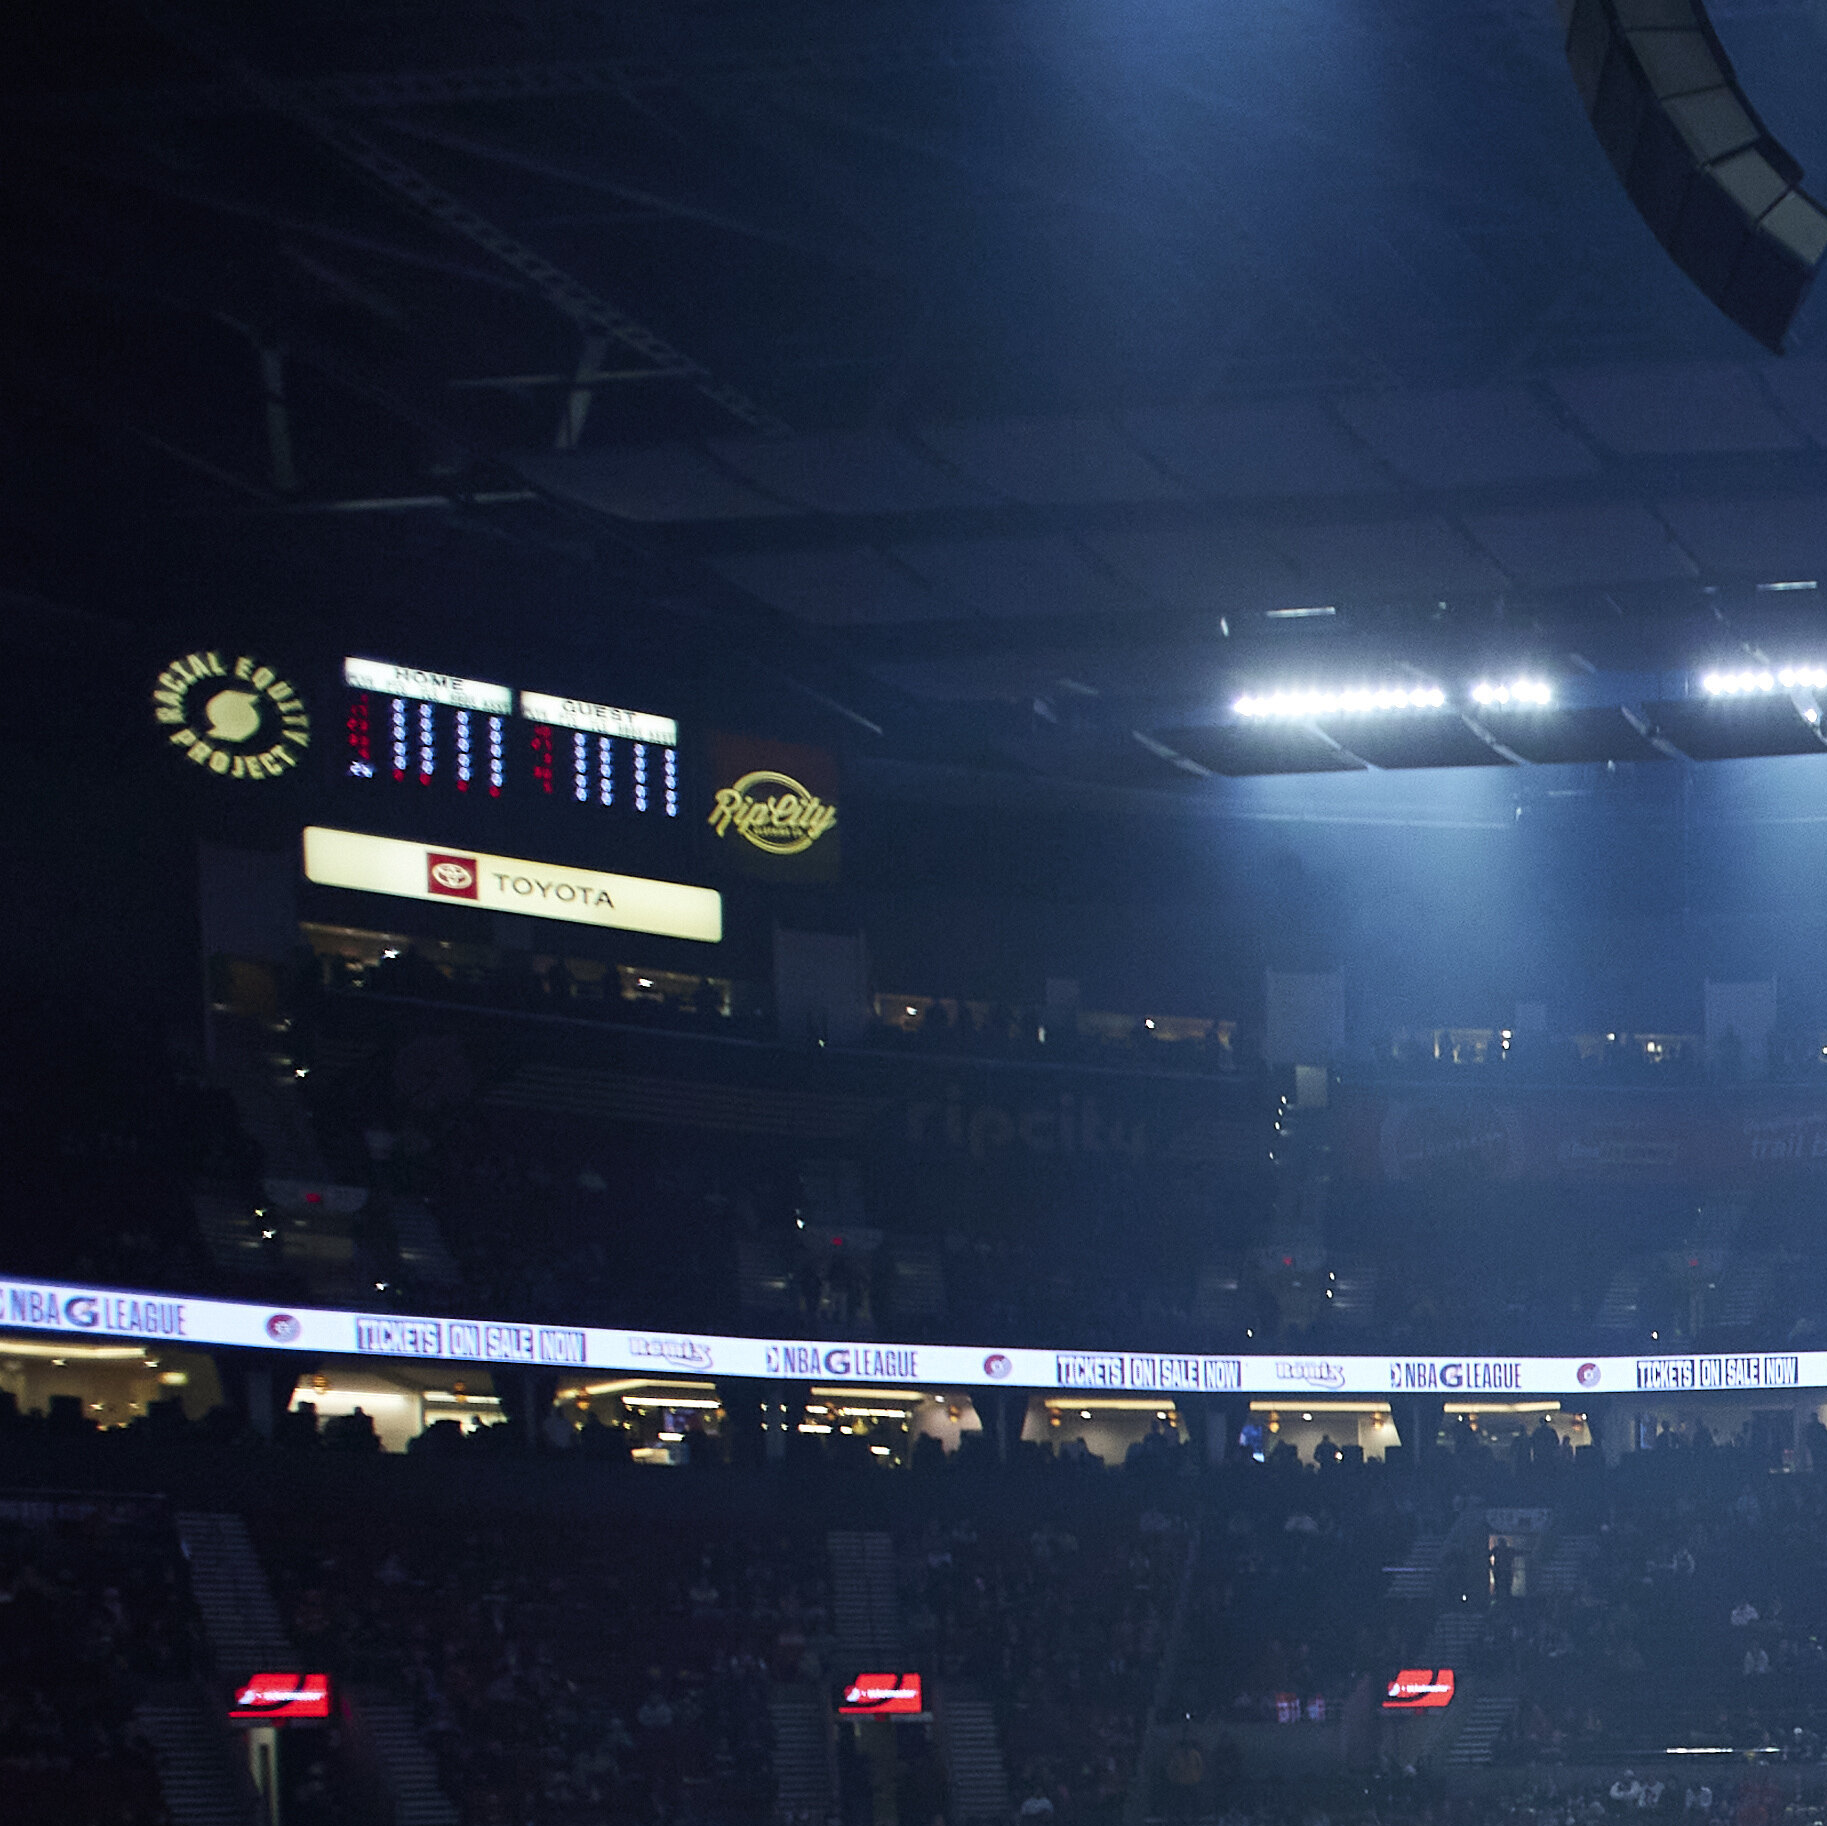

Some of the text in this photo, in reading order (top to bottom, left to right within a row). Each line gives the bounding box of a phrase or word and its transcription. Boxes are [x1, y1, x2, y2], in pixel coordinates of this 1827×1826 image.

[154, 651, 227, 723] RACIAL
[395, 668, 463, 694] HOME
[235, 656, 310, 748] EQUITY
[562, 700, 637, 728] GUEST
[169, 728, 297, 780] PROJECT
[493, 872, 616, 909] TOYOTA
[10, 1288, 188, 1336] NBA G LEAGUE
[357, 1321, 587, 1362] TICKETS ON SALE NOW
[783, 1347, 919, 1379] NBA G LEAGUE
[1057, 1356, 1241, 1389] TICKETS ON SALE NOW
[1405, 1363, 1522, 1390] NBA G LEAGUE
[1636, 1356, 1798, 1389] TICKETS ON SALE NOW
